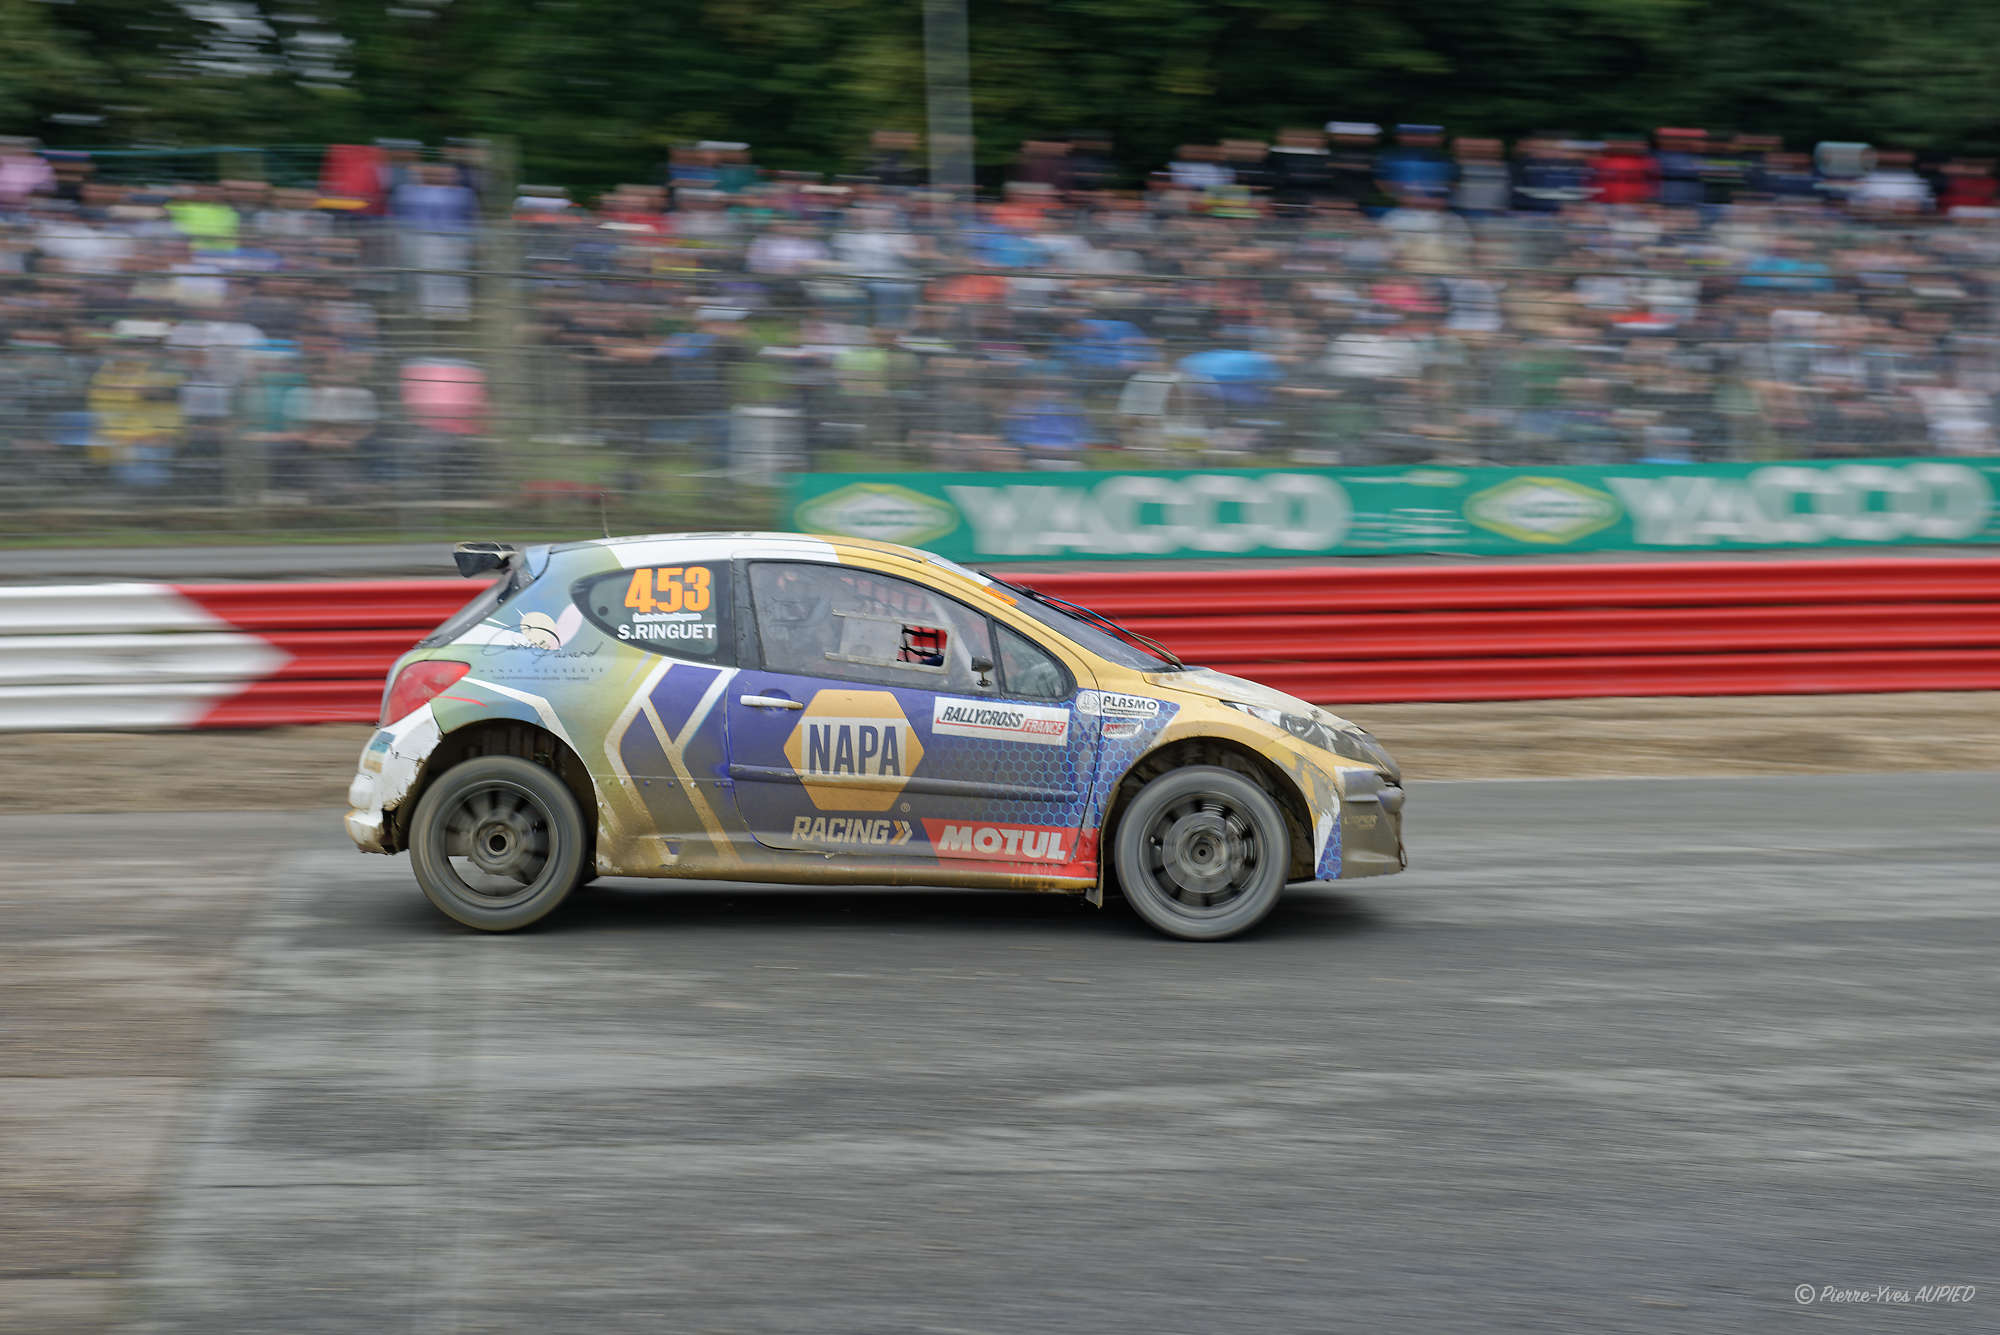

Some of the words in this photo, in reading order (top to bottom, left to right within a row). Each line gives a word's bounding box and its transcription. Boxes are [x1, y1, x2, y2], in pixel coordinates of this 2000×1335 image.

[624, 566, 711, 612] 453
[617, 624, 716, 640] S.RINGUET
[1103, 695, 1157, 711] PLASMO
[942, 706, 1024, 728] RALLYCROSS
[1025, 719, 1066, 735] FRANCE
[809, 724, 901, 776] NAPA
[792, 816, 891, 845] RACING
[937, 825, 1066, 860] MOTUL
